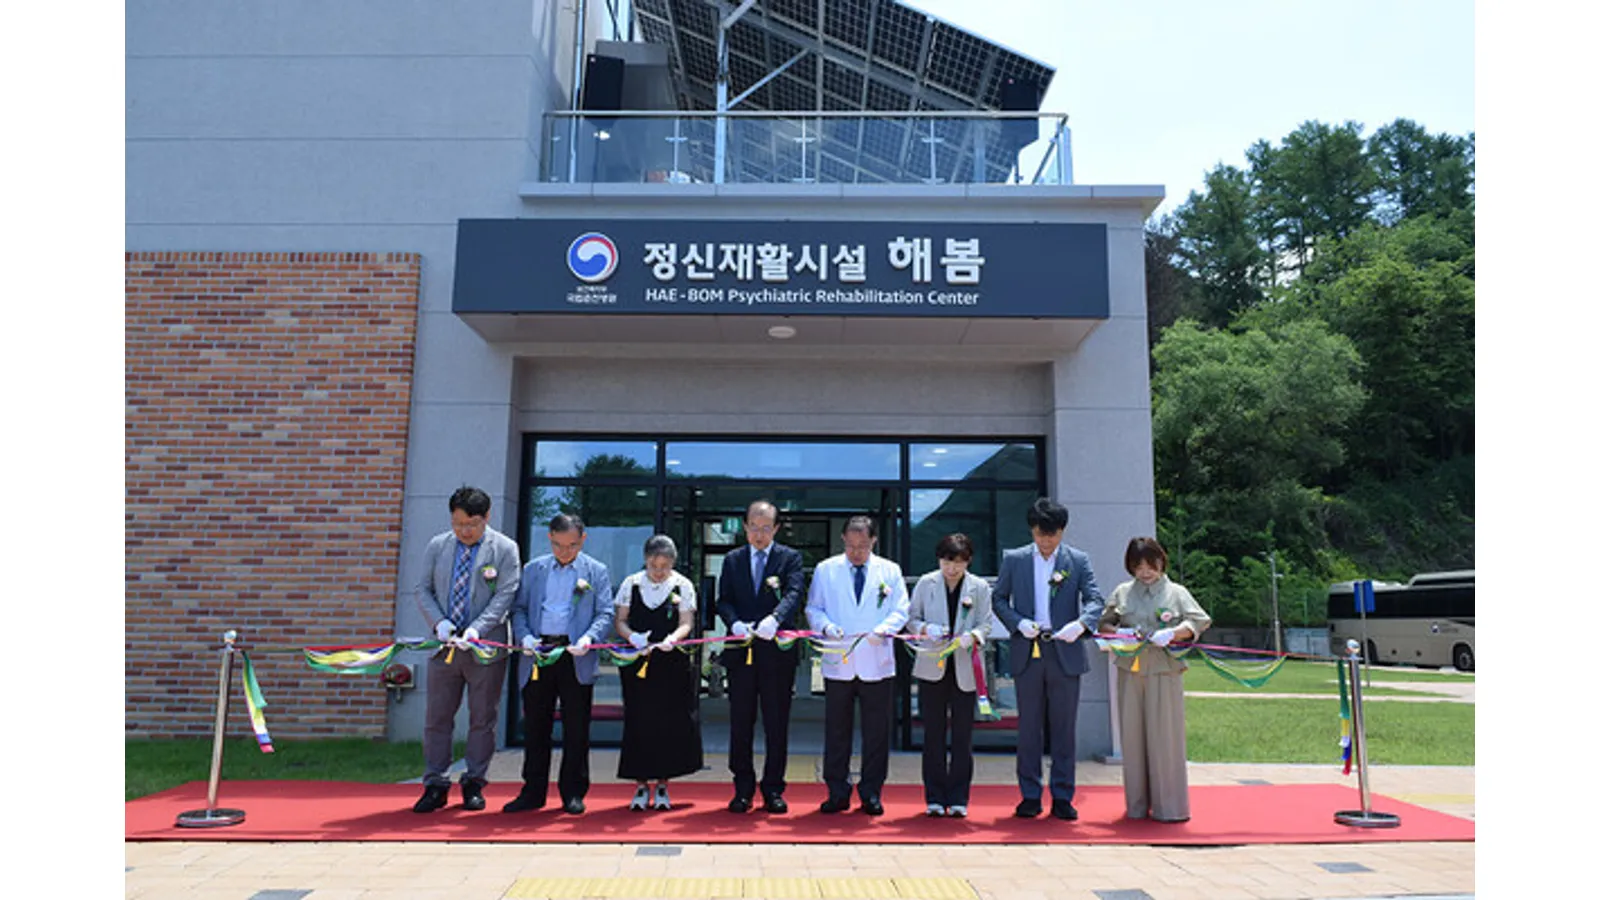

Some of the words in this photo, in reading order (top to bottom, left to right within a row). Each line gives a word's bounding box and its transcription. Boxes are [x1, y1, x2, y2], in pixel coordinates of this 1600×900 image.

[643, 242, 867, 281] 정신재활시설
[888, 237, 985, 283] 해봄
[728, 289, 812, 304] Psychiatric
[816, 289, 923, 304] Rehabilitation
[927, 291, 979, 304] Center
